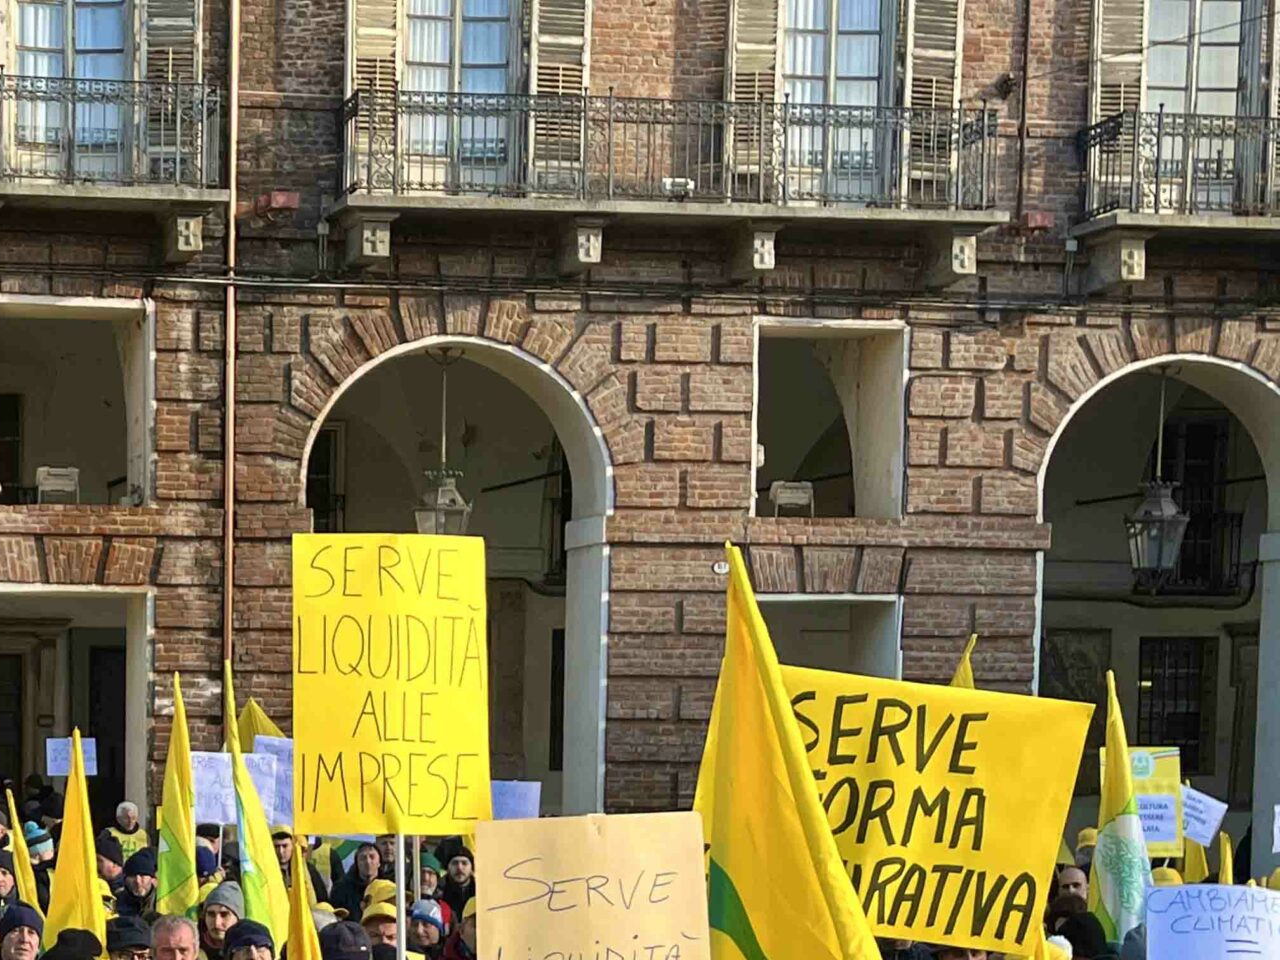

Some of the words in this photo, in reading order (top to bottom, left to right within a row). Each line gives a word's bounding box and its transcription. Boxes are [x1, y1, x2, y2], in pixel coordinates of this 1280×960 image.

[305, 545, 459, 601] SERVE
[297, 604, 483, 690] LIQUIDITÀ
[352, 691, 438, 743] ALLE
[791, 690, 990, 775] SERVE
[300, 751, 480, 820] IMPRESE
[487, 858, 678, 912] SERVE
